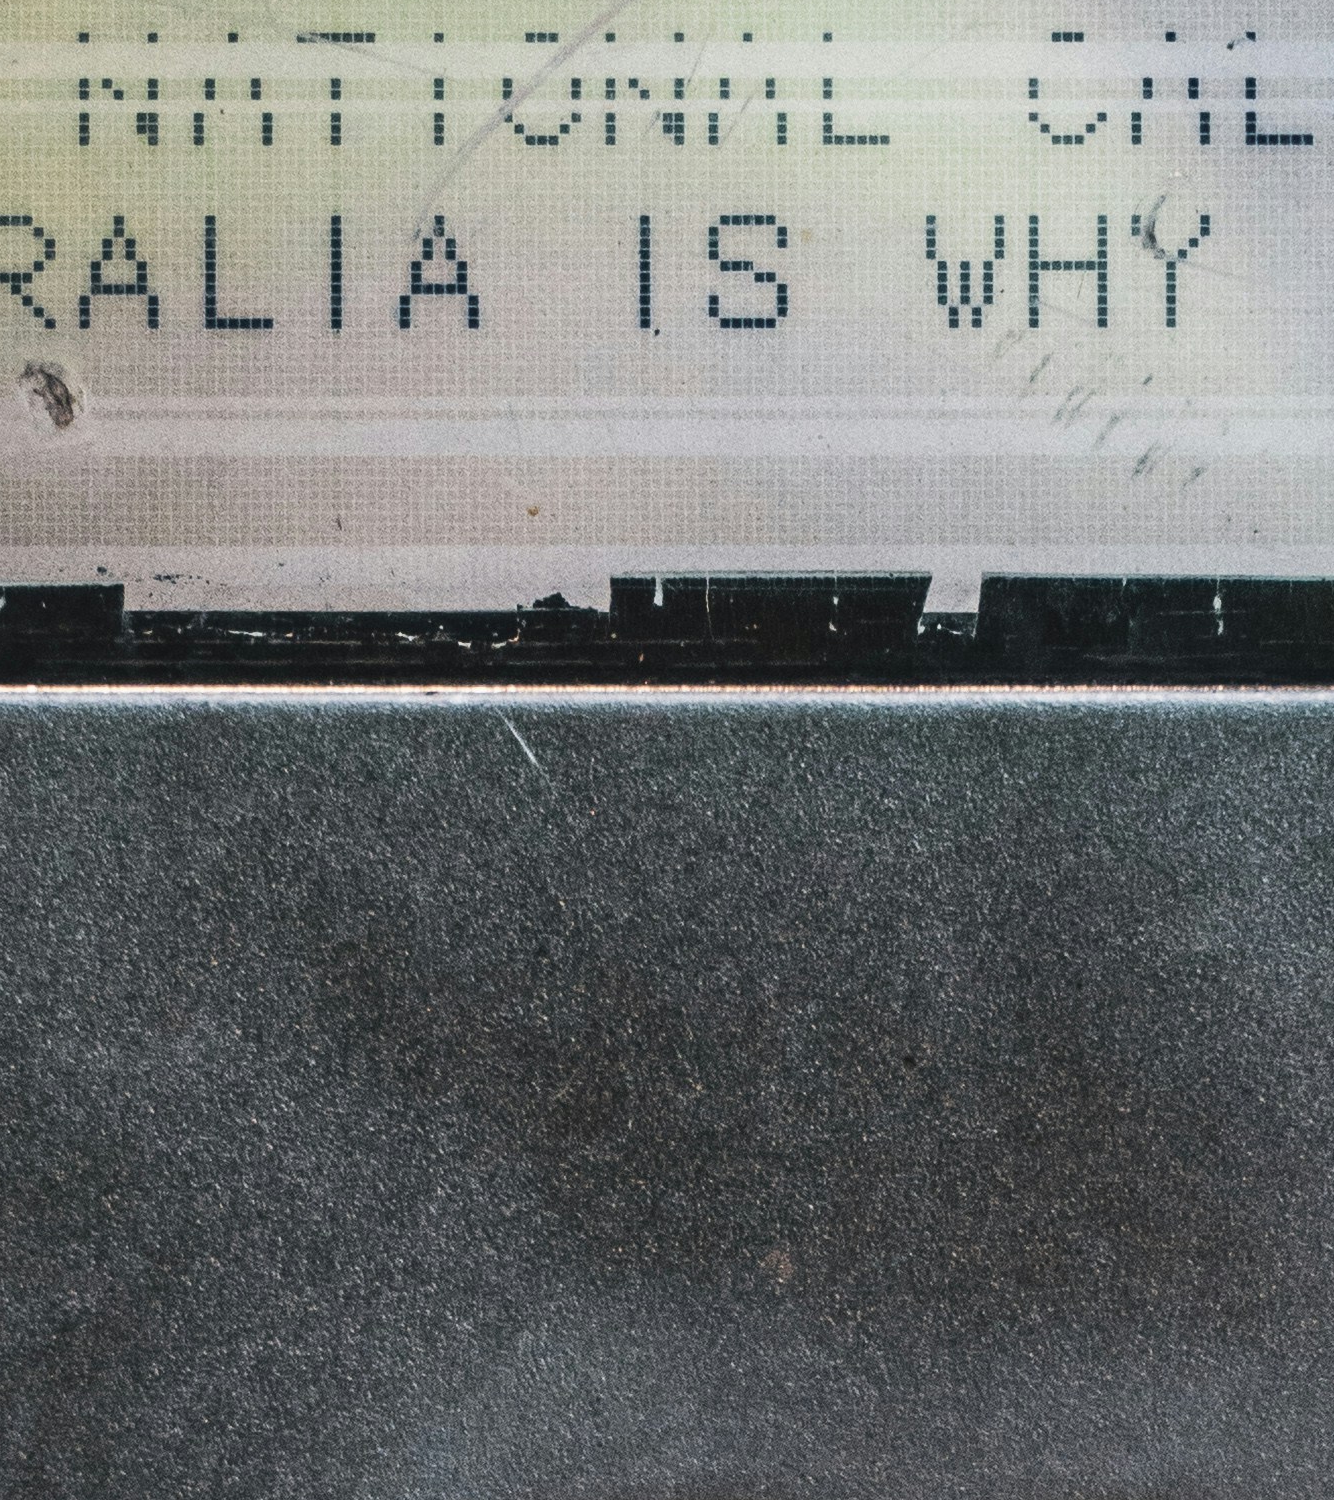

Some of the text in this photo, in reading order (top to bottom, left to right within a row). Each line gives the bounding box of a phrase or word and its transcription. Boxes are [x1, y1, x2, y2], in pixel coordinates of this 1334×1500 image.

[77, 31, 891, 147] NATIONAL
[638, 214, 790, 330] IS
[923, 214, 1211, 330] WHY
